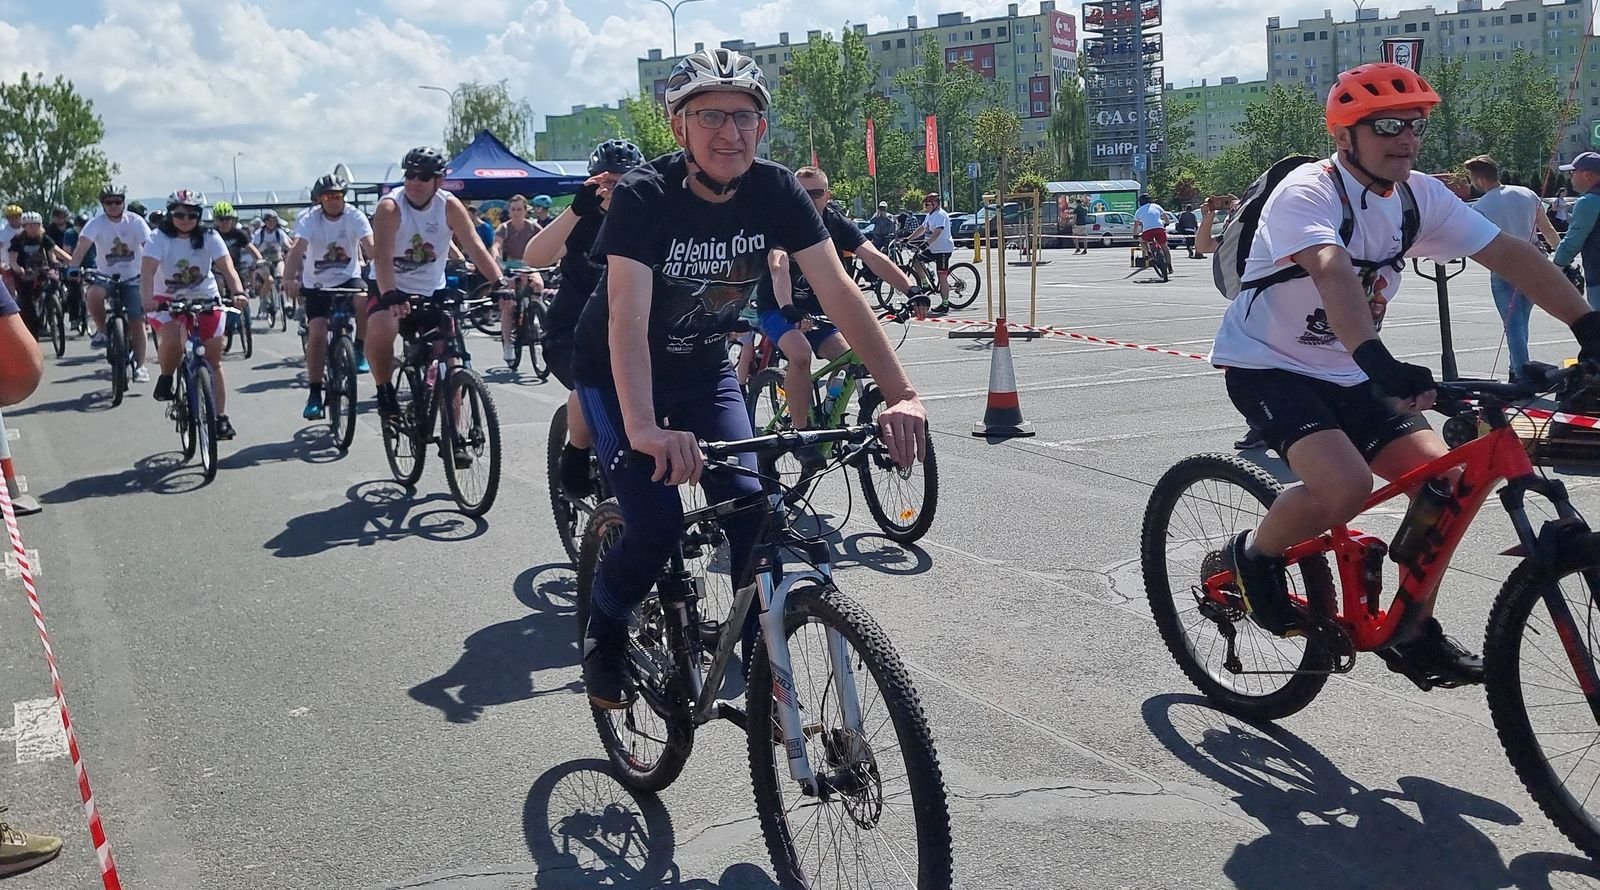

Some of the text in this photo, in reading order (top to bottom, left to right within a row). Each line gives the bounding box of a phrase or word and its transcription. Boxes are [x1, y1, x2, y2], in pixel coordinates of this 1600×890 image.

[1096, 142, 1158, 156] HalfPrce
[665, 237, 727, 262] Jelenia
[662, 259, 734, 278] na rowery
